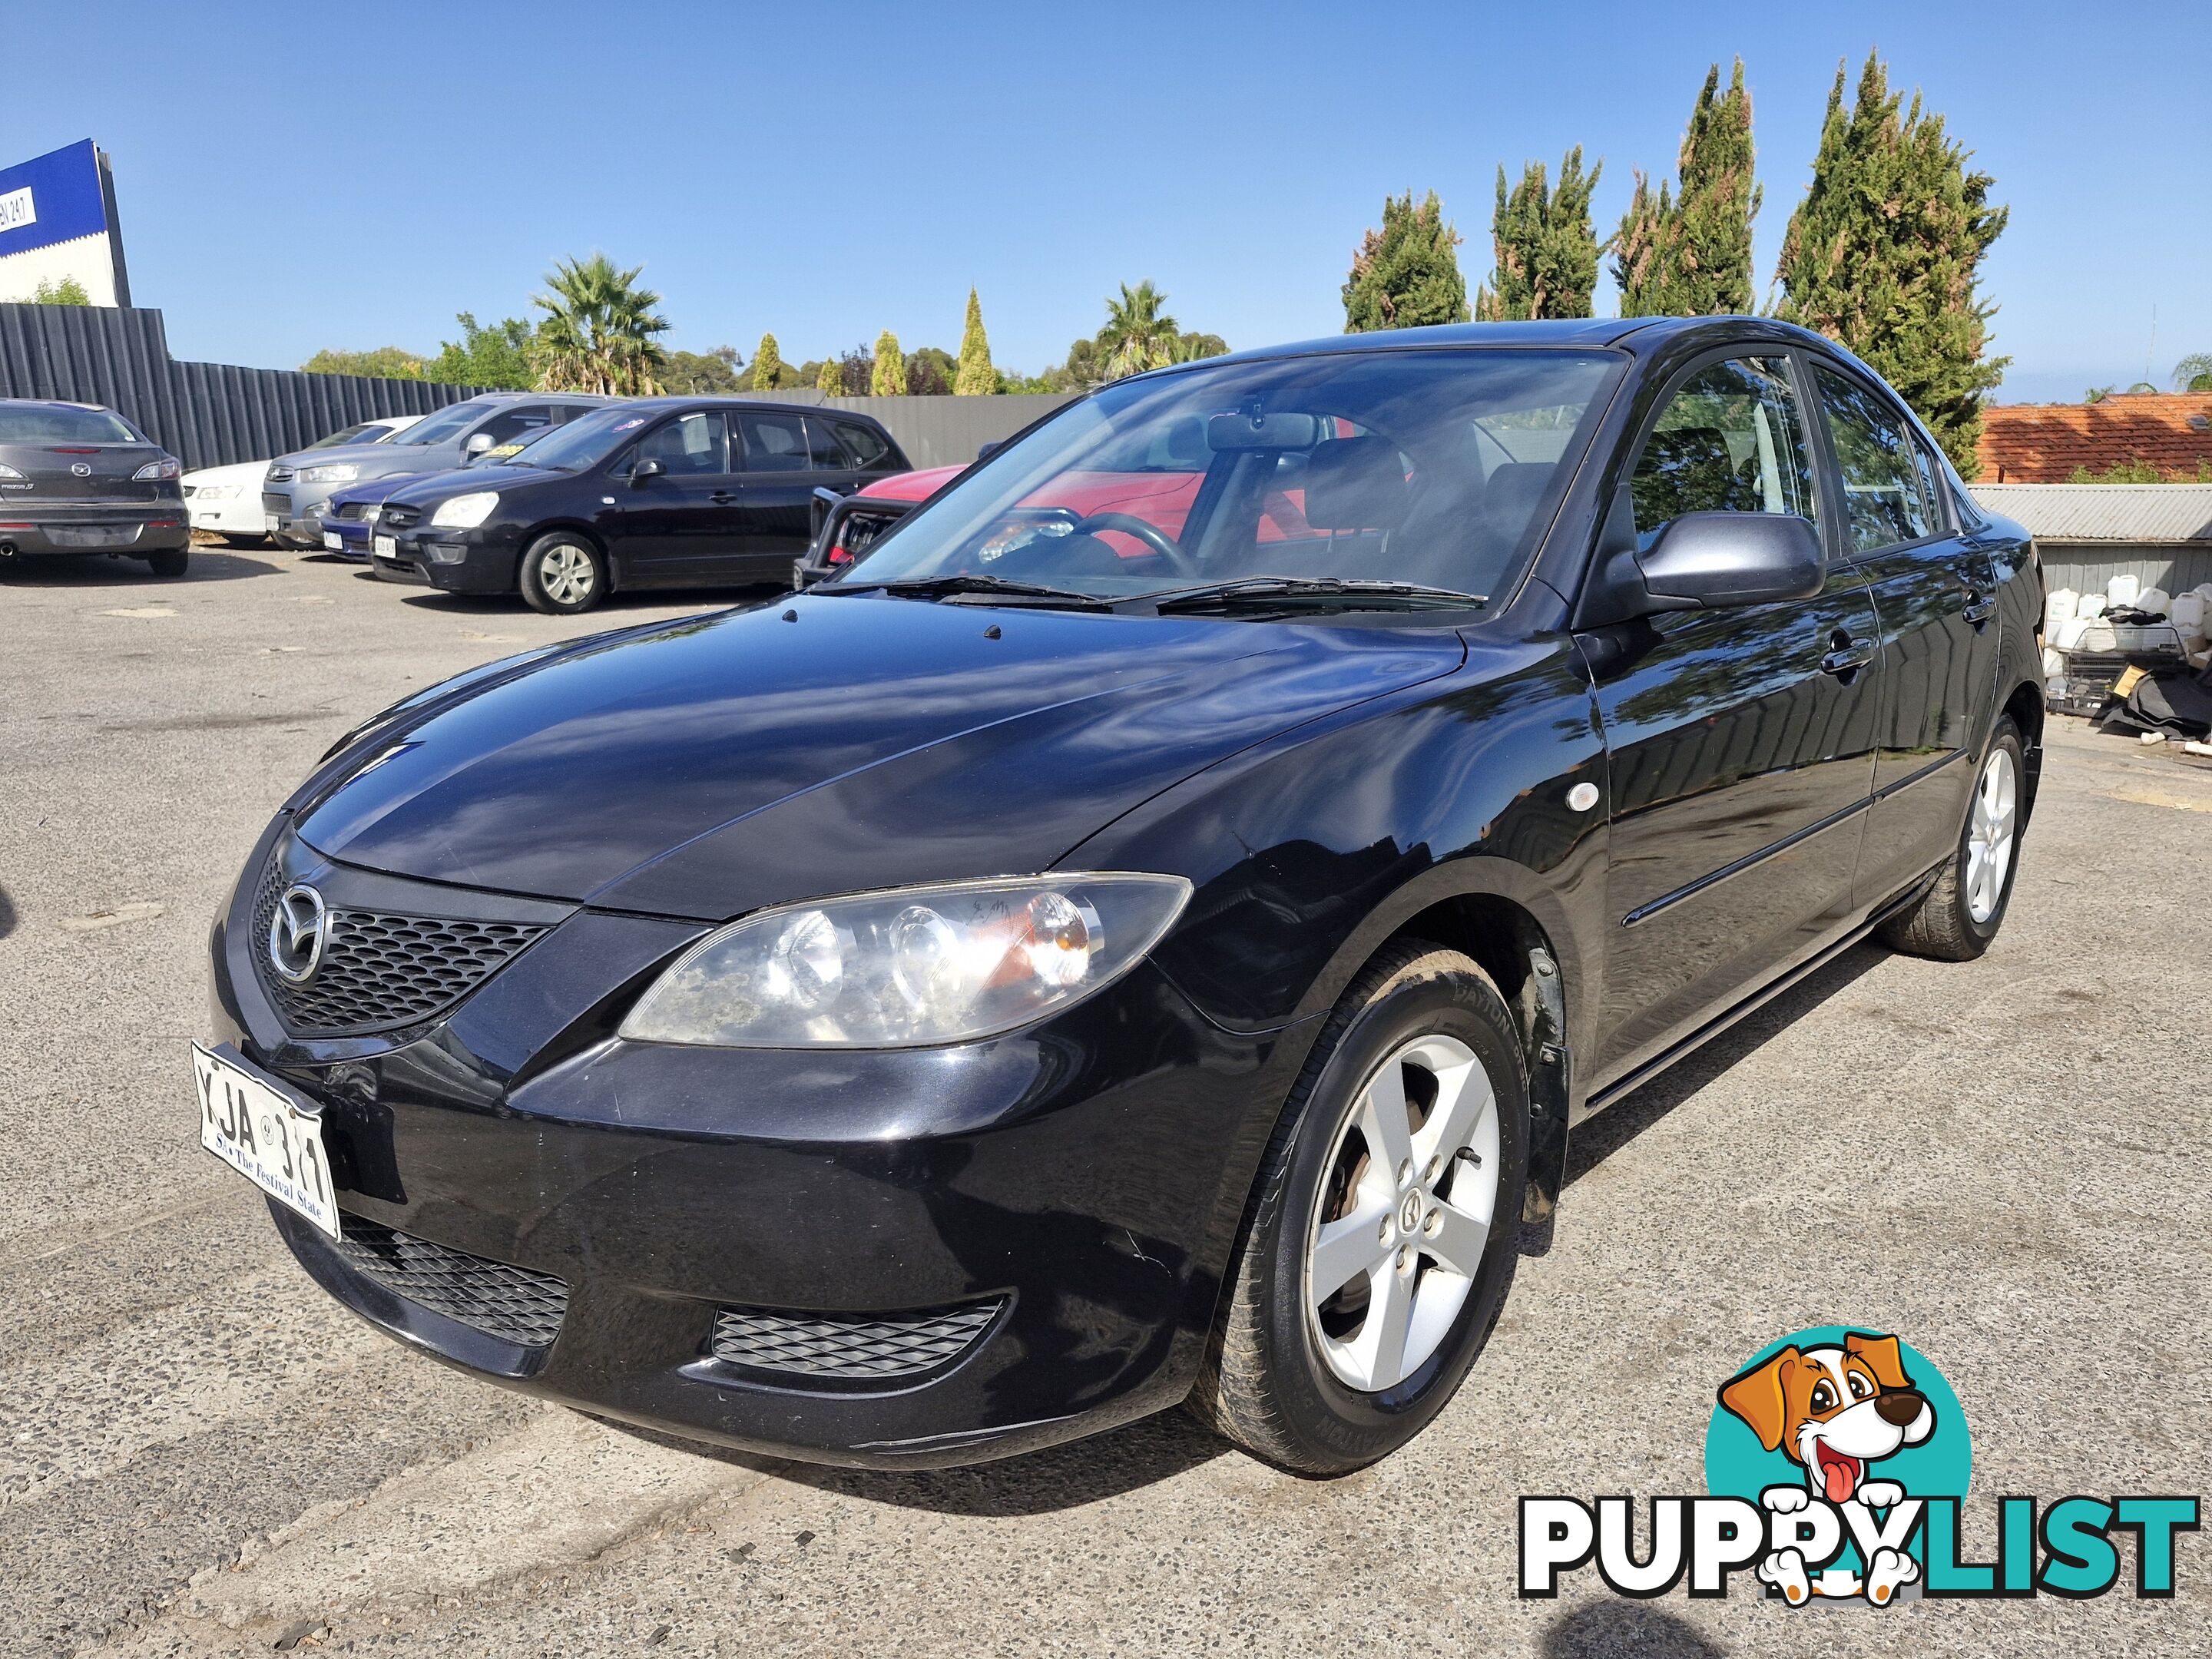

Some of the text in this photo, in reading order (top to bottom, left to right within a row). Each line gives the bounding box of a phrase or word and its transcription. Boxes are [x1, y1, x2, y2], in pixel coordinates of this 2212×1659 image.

[1454, 982, 1511, 1037] DAYTON
[197, 1065, 256, 1156] XJA
[235, 1149, 253, 1171] The
[257, 1162, 294, 1200] Festival
[296, 1189, 323, 1220] State
